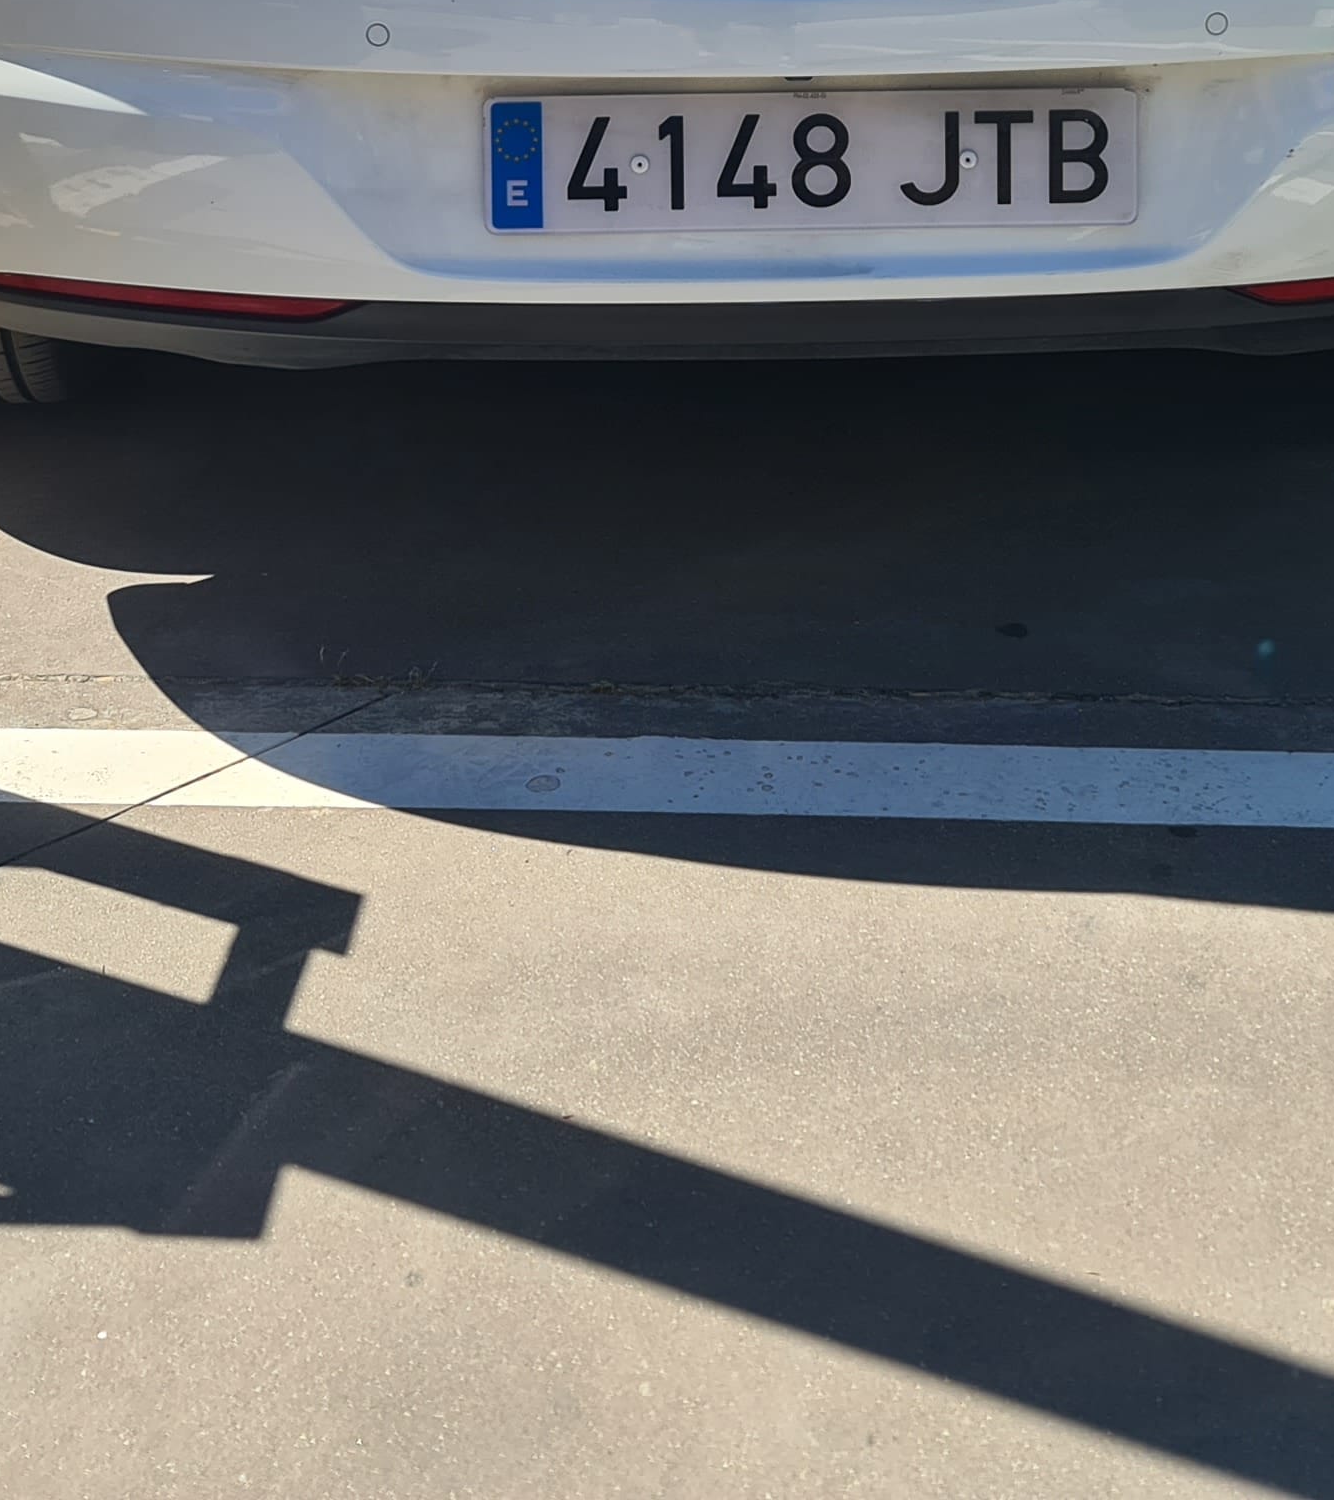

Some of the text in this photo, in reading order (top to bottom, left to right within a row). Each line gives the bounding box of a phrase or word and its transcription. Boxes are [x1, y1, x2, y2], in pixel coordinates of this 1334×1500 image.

[506, 179, 529, 207] E
[566, 108, 1110, 212] 4148 JTB
